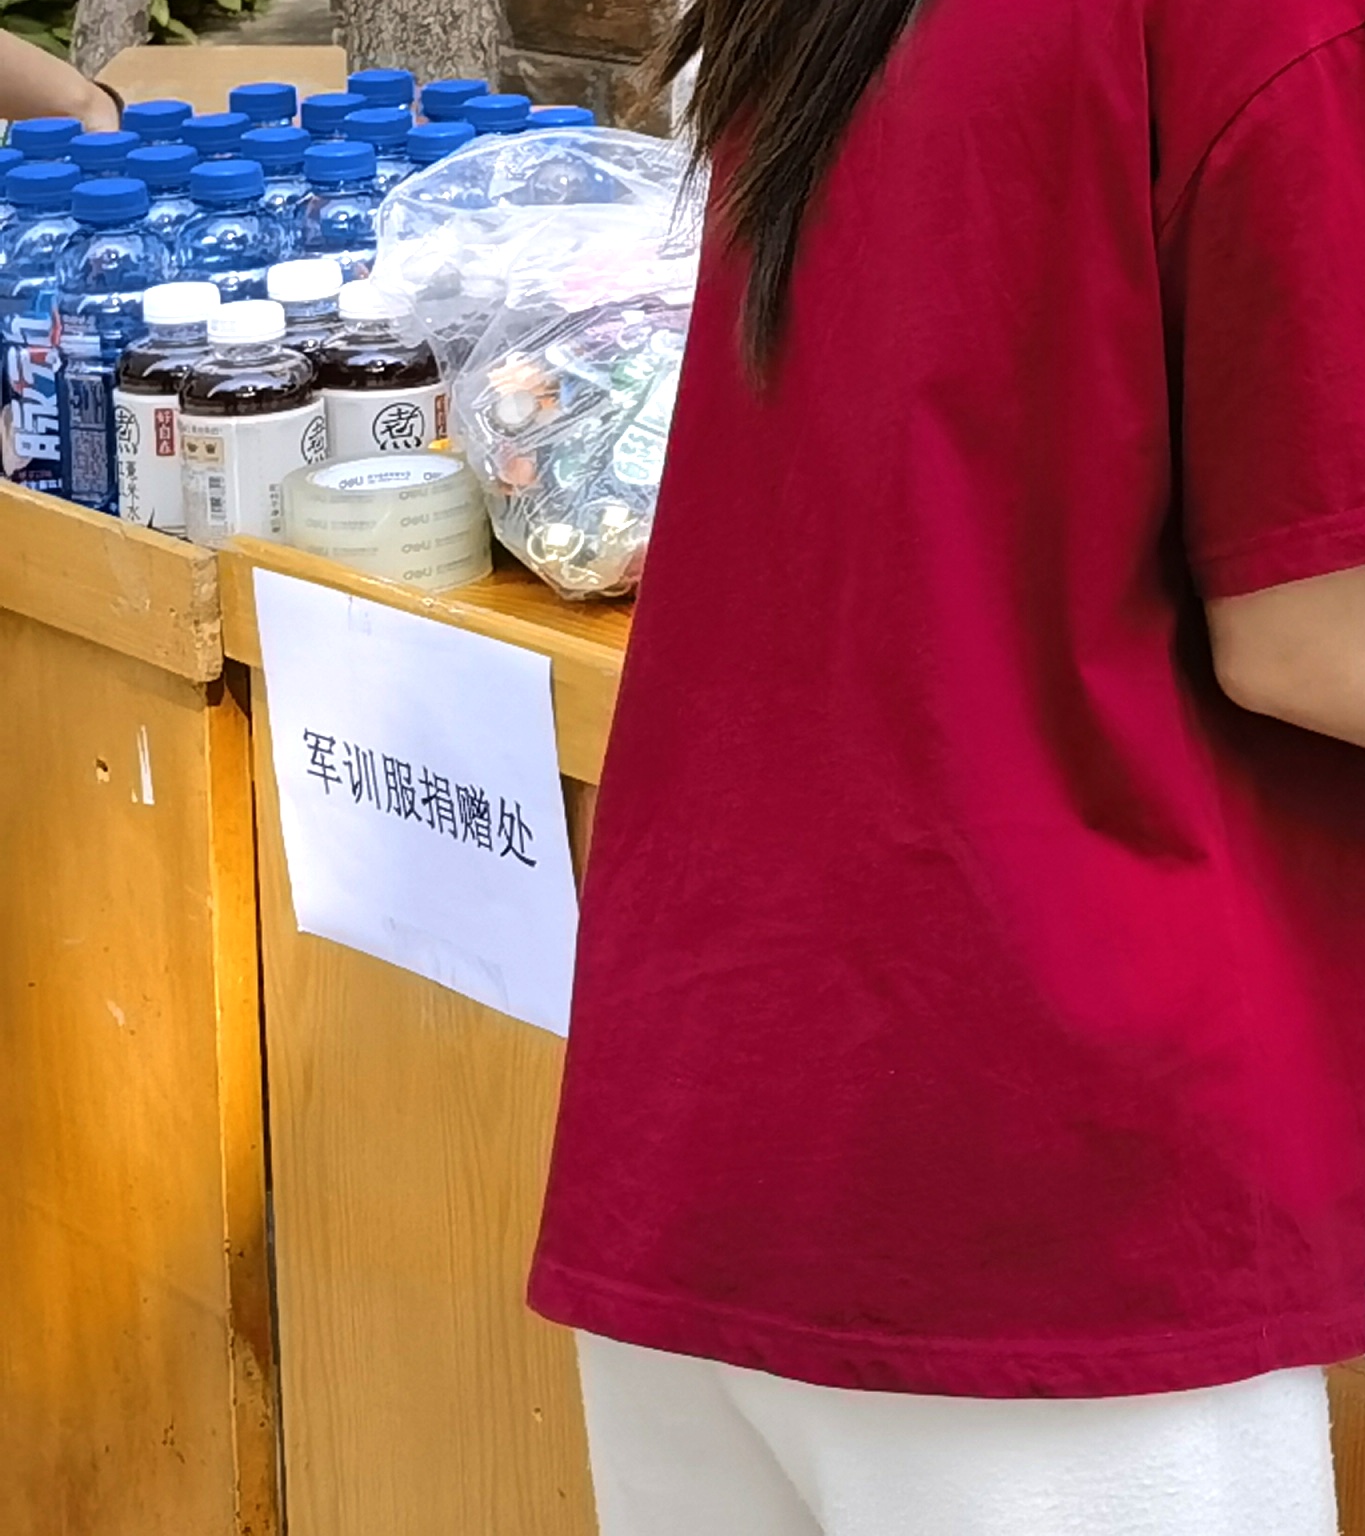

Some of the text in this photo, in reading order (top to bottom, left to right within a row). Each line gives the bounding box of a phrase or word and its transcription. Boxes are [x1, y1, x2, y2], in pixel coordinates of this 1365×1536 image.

[302, 727, 537, 868] 军训服捐赠处
